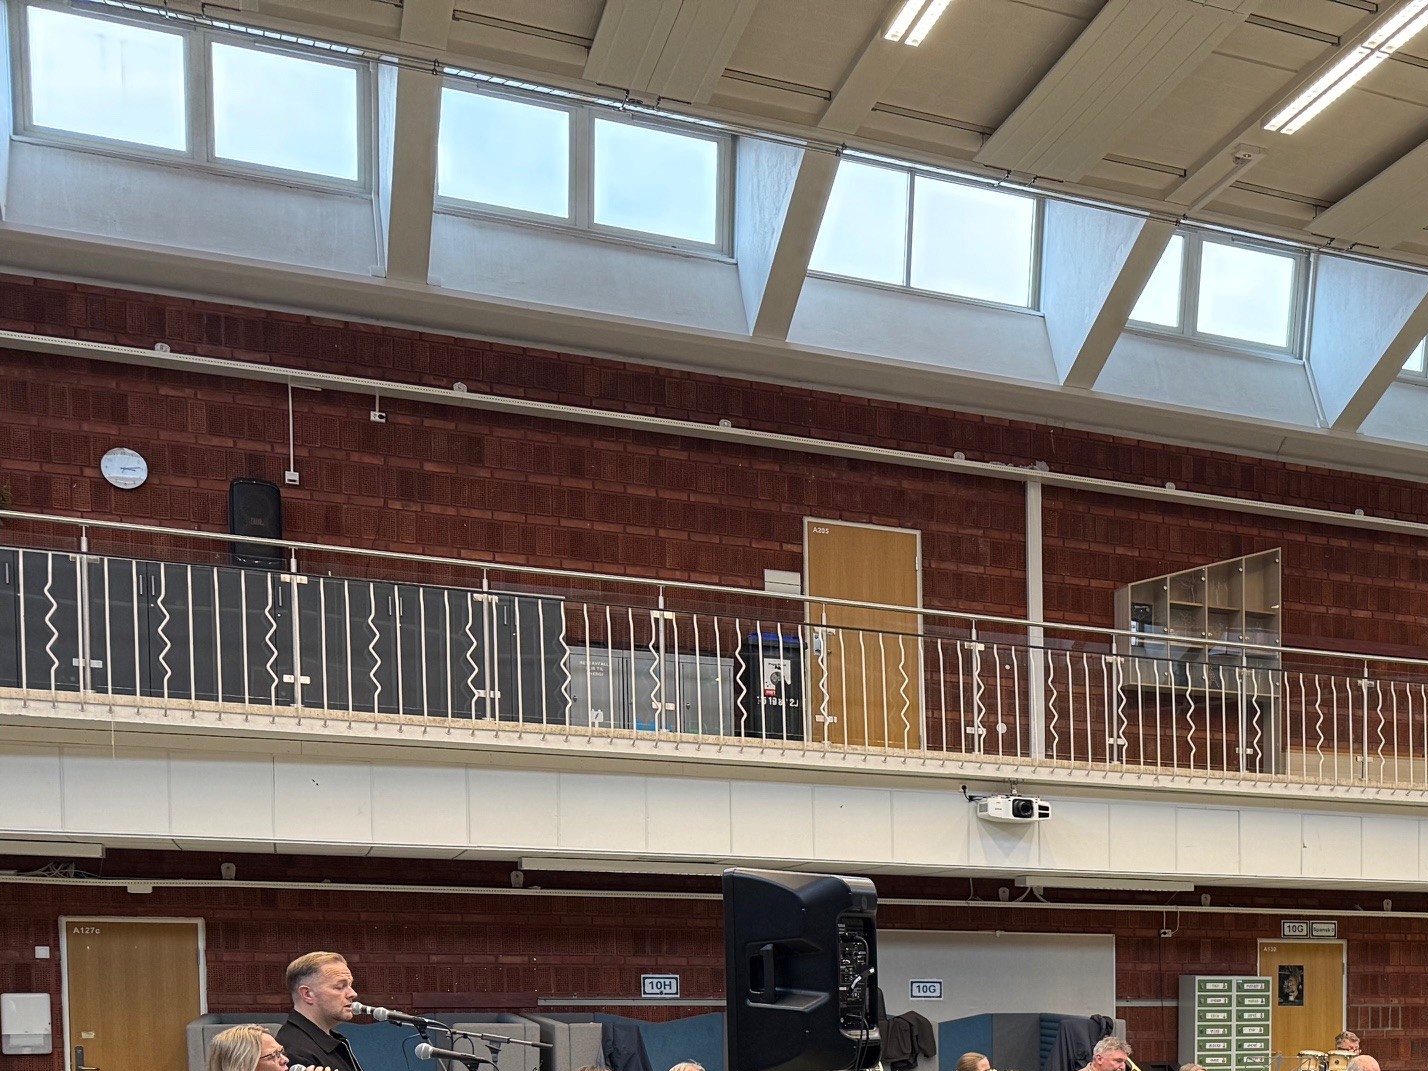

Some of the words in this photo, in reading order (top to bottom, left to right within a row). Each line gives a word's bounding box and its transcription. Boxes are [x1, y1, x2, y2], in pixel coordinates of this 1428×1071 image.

[72, 926, 101, 935] A127c
[1286, 924, 1304, 933] 10G
[648, 979, 673, 991] 10H
[914, 984, 937, 994] 10G
